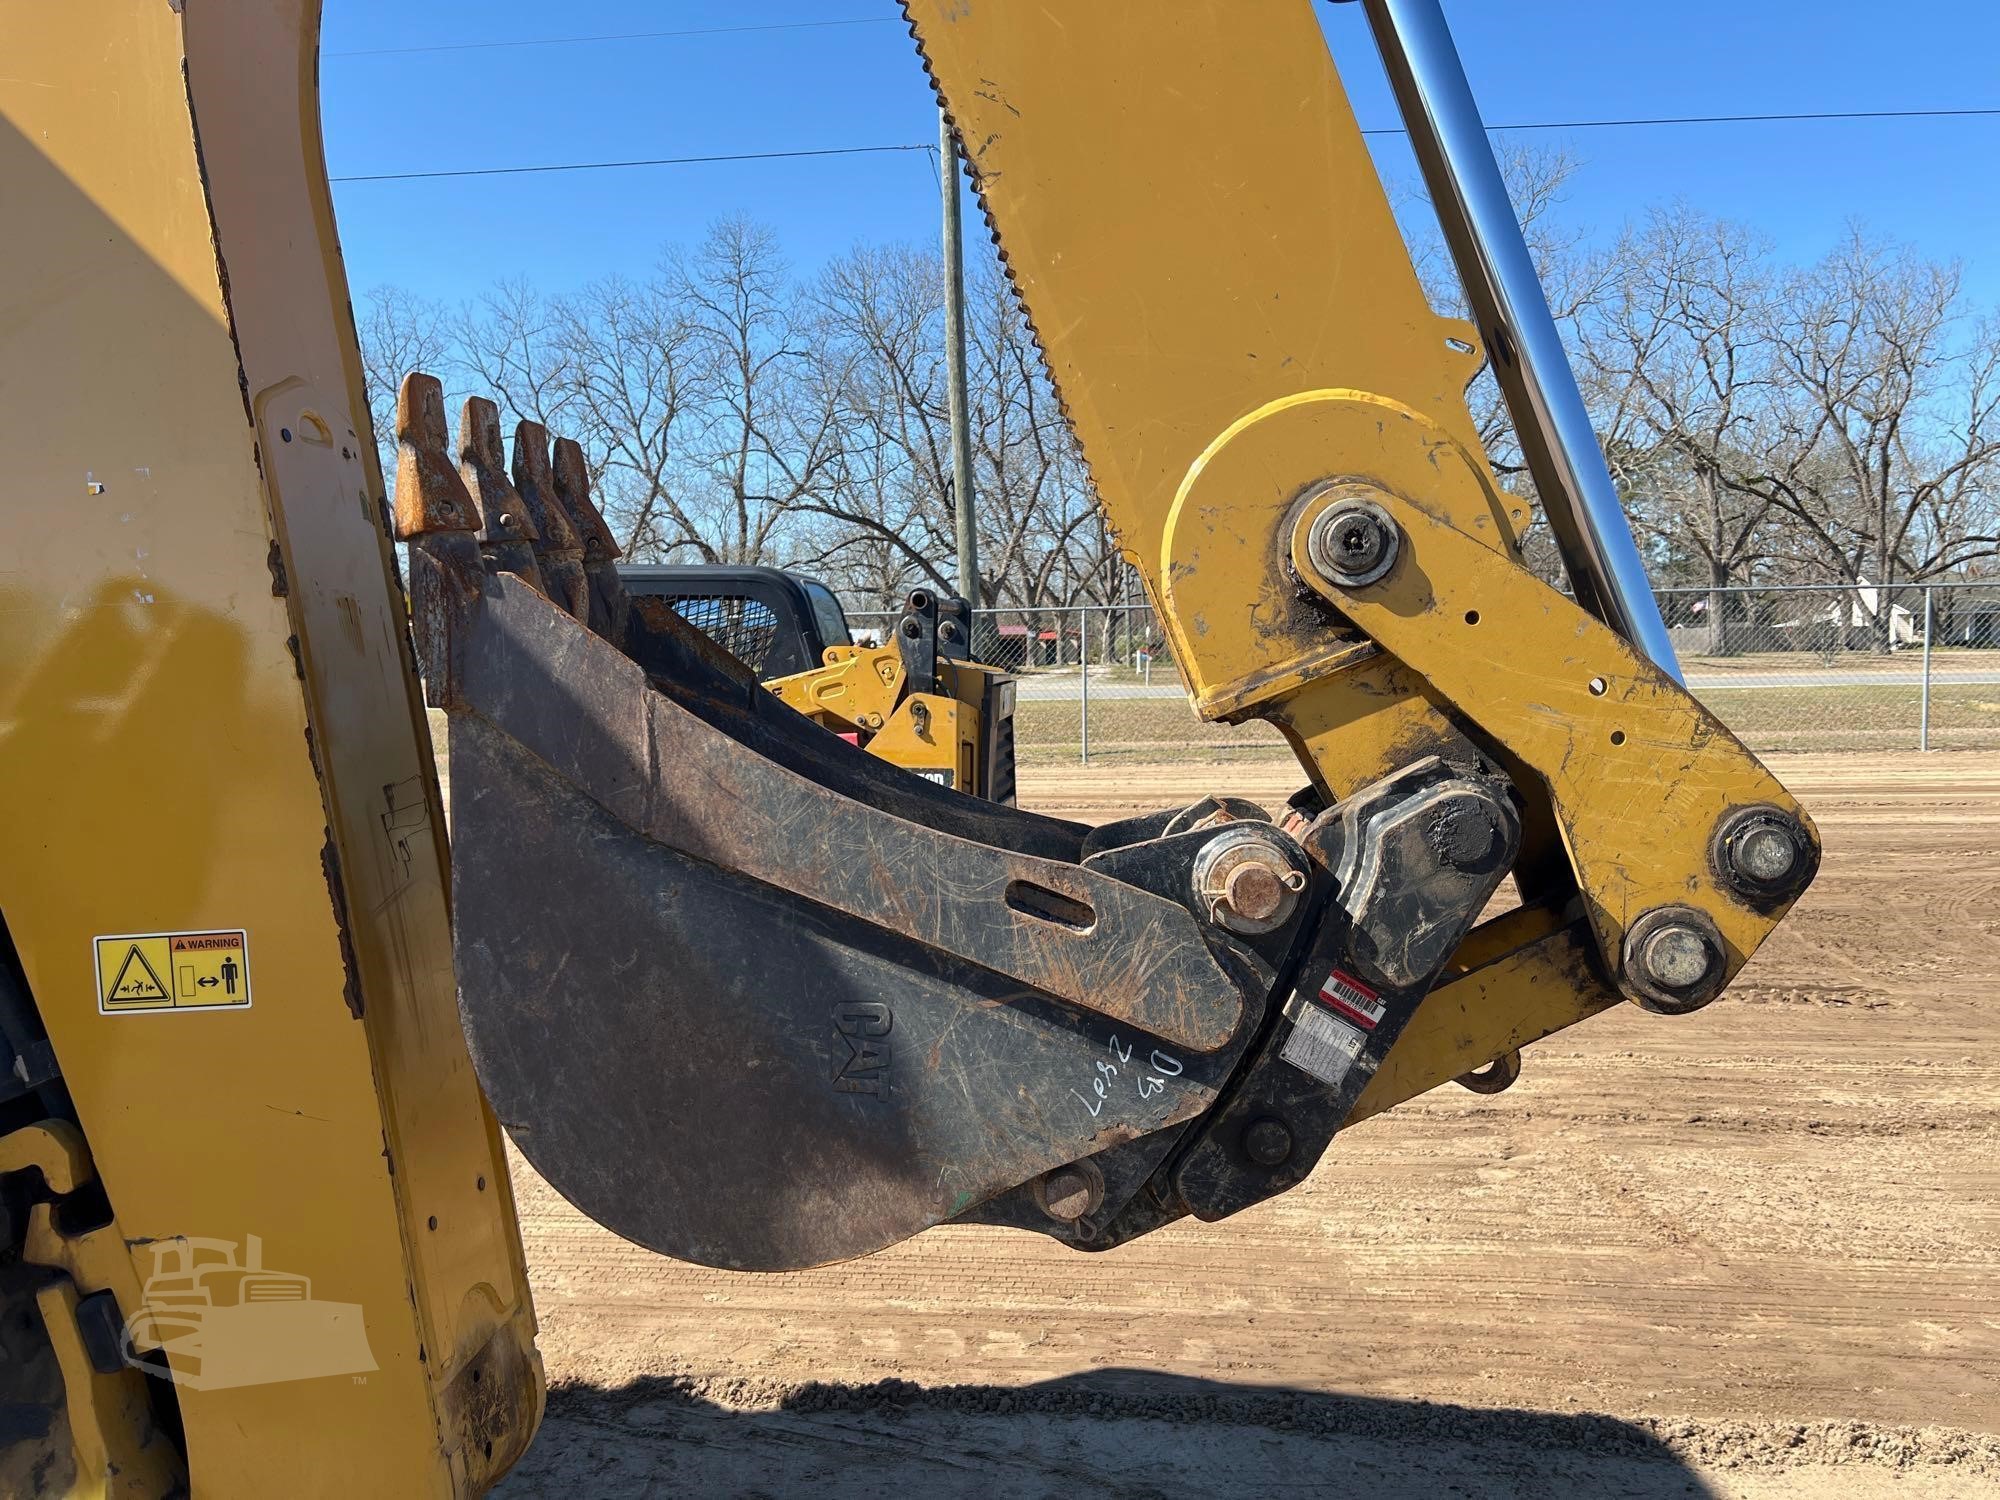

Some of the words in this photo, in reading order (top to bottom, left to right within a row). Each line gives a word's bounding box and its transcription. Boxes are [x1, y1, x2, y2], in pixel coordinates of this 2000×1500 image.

[188, 938, 240, 950] WARNING
[1377, 997, 1387, 1005] CAT
[831, 1000, 894, 1104] CAT
